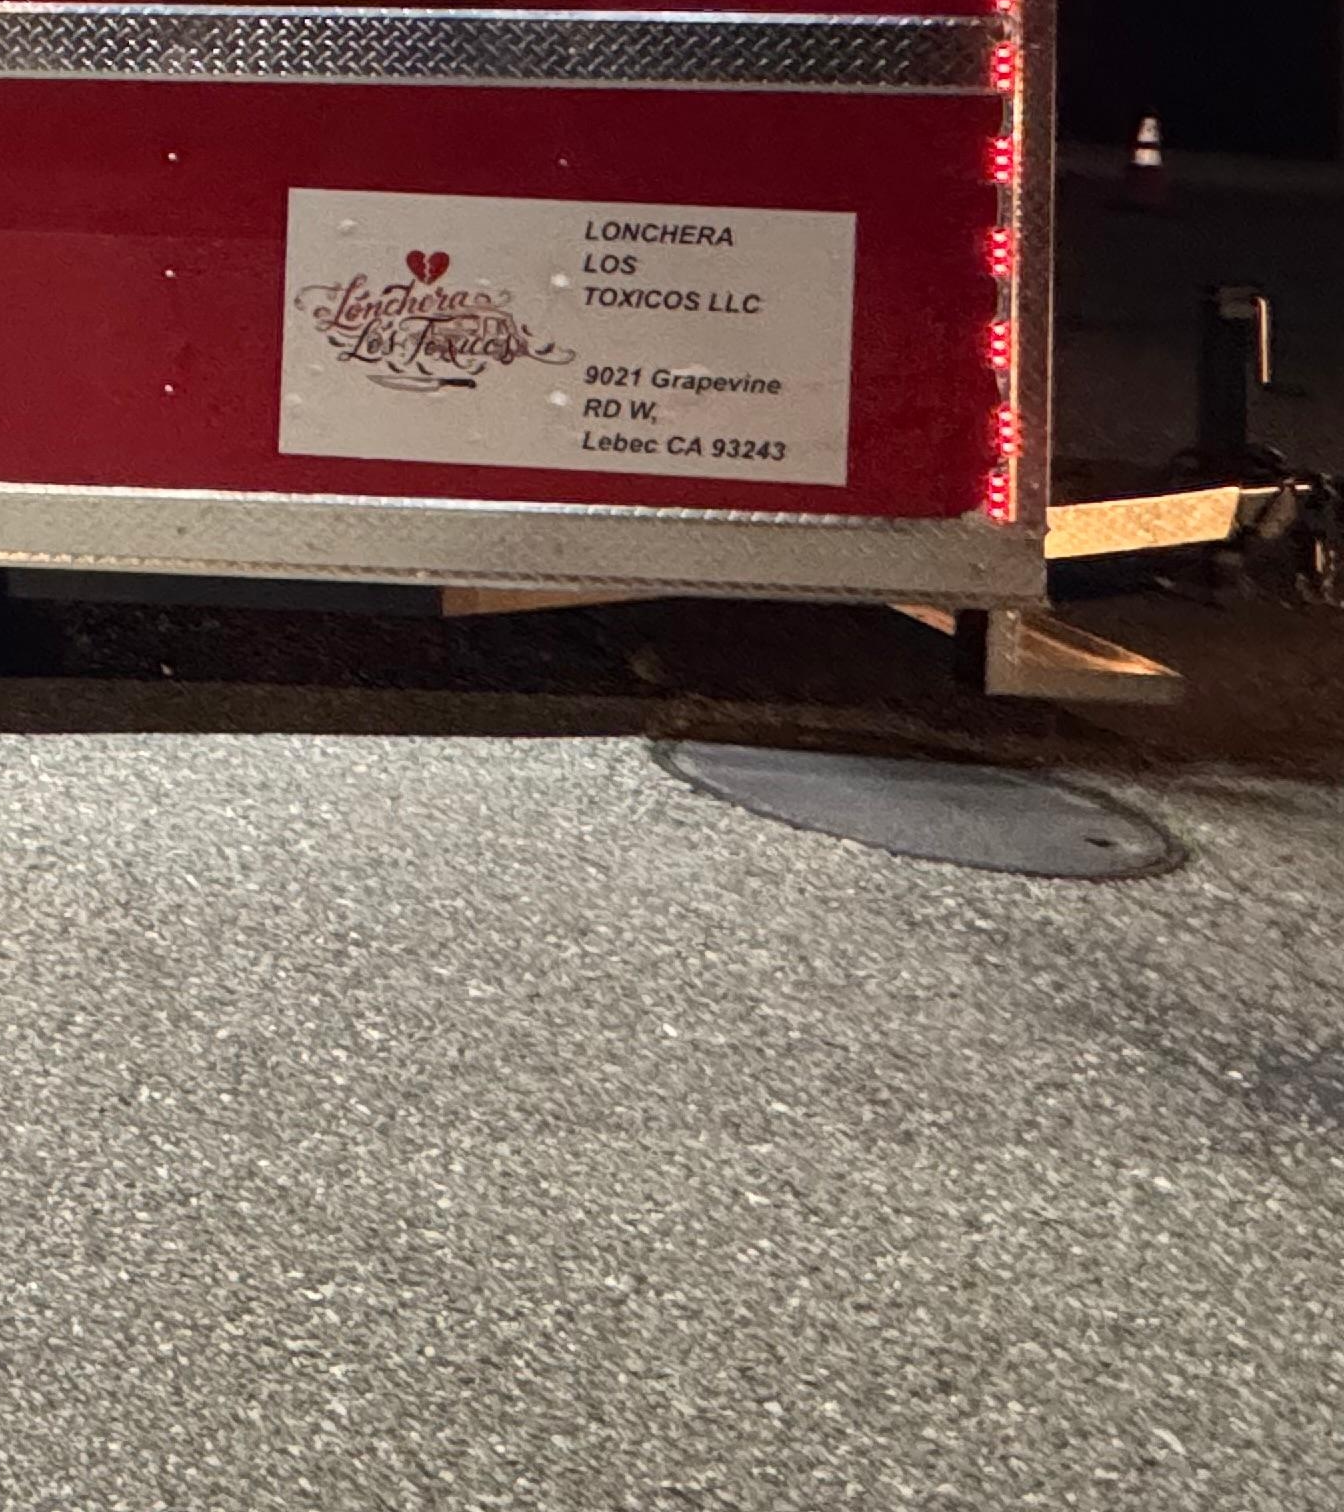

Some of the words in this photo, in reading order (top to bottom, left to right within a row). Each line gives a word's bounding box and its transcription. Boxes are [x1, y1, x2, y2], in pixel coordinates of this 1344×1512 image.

[584, 220, 735, 247] LONCHERA
[583, 253, 638, 276] LOS
[310, 273, 496, 332] Lonchera
[584, 286, 702, 312] TOXICOS
[708, 291, 761, 315] LLC
[335, 318, 398, 364] Los
[583, 365, 643, 387] 9021
[650, 368, 783, 395] Grapevine
[582, 398, 622, 419] RD
[629, 399, 658, 425] W,
[581, 431, 659, 454] Lebec
[666, 435, 703, 457] CA
[711, 438, 787, 462] 93243
